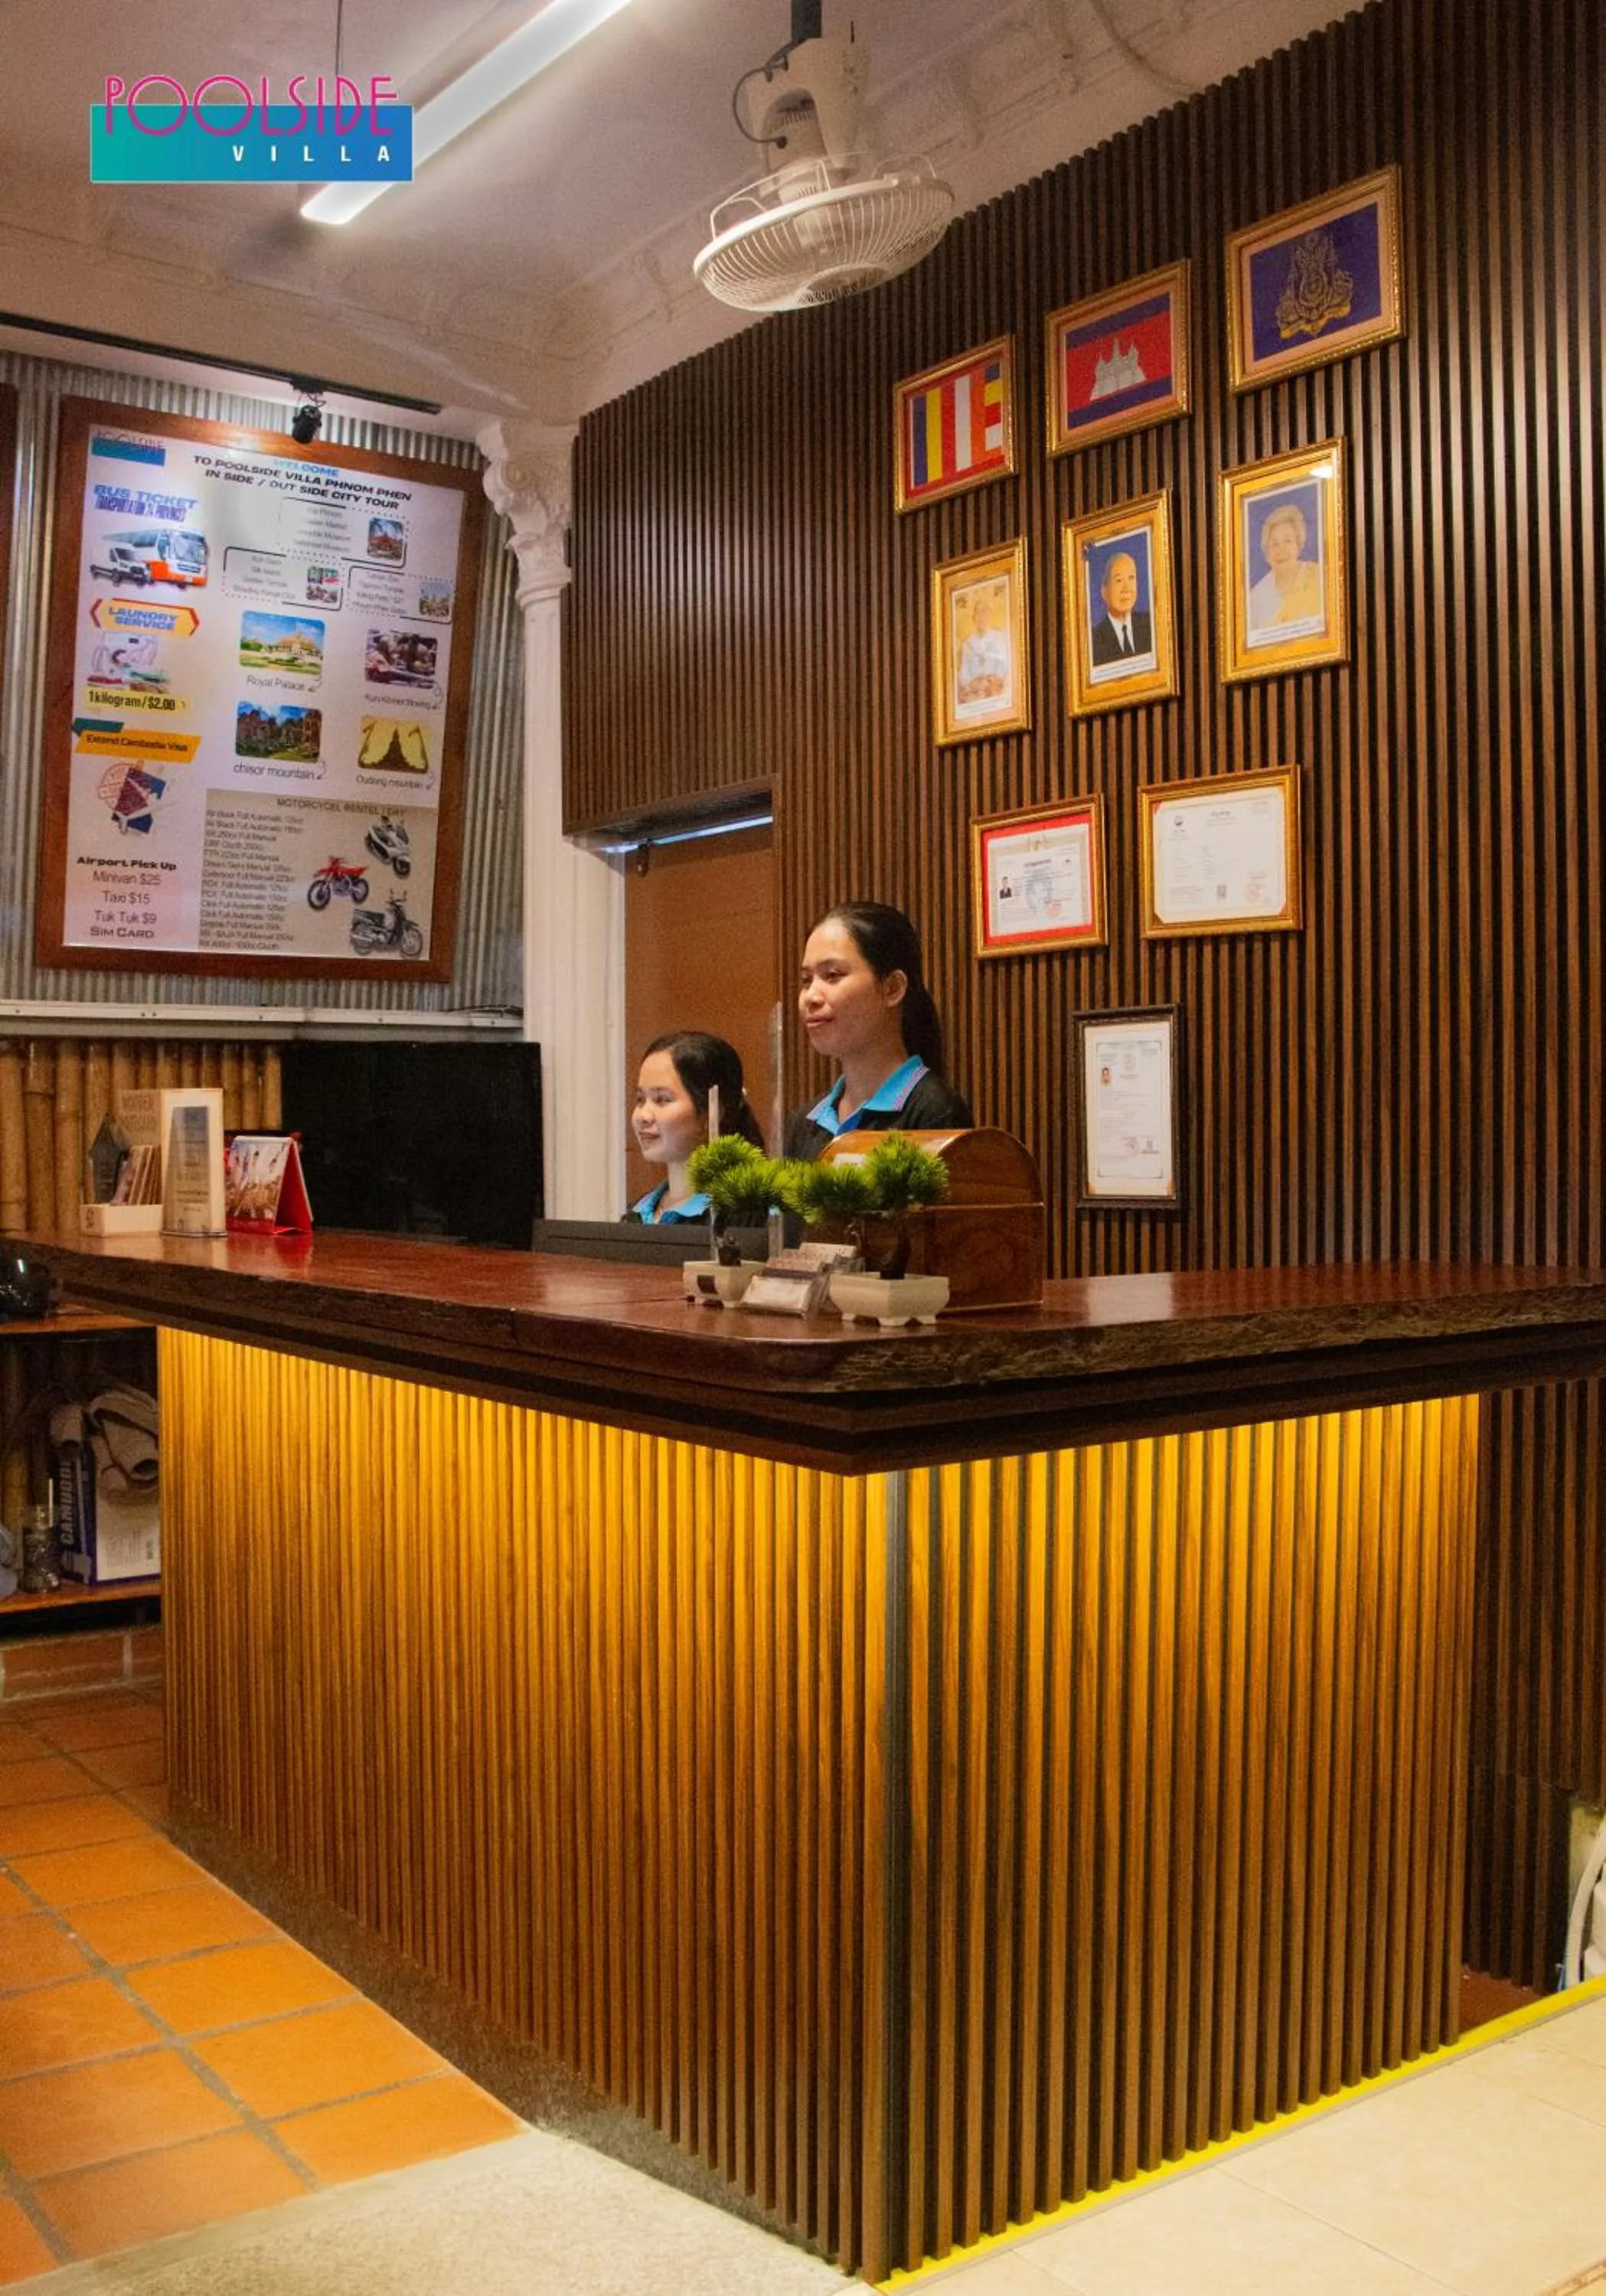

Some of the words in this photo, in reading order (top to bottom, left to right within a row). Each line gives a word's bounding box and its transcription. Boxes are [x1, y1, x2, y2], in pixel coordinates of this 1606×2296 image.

[273, 459, 340, 477] WELCOME
[193, 455, 213, 466] TO
[214, 458, 281, 478] POOLSIDE
[284, 471, 322, 486] VILLA
[324, 478, 376, 494] PHNOM
[376, 488, 413, 501] PHEN
[94, 484, 131, 498] BUS
[136, 491, 198, 509] TICKET
[204, 469, 221, 480] IN
[223, 473, 255, 485] SIDE
[269, 479, 296, 492] OUT
[299, 484, 329, 498] SIDE
[331, 490, 363, 504] CITY
[364, 496, 402, 510] TOUR
[108, 606, 178, 621] LAUNDRY
[115, 616, 176, 631] SERVICE
[246, 673, 274, 689] Royal
[273, 677, 306, 690] Palace
[148, 697, 176, 711] $2.00
[233, 762, 265, 776] chisor
[267, 765, 315, 780] mountain
[76, 856, 129, 867] Airport
[129, 859, 158, 870] Pick
[159, 862, 177, 872] Up
[92, 870, 137, 885] Minivan
[139, 872, 162, 886] $25
[100, 890, 127, 903] Taxi
[128, 892, 152, 906] $15
[94, 909, 116, 921] Tuk
[118, 911, 140, 925] Tuk
[142, 912, 158, 925] $9
[116, 927, 155, 939] CARD
